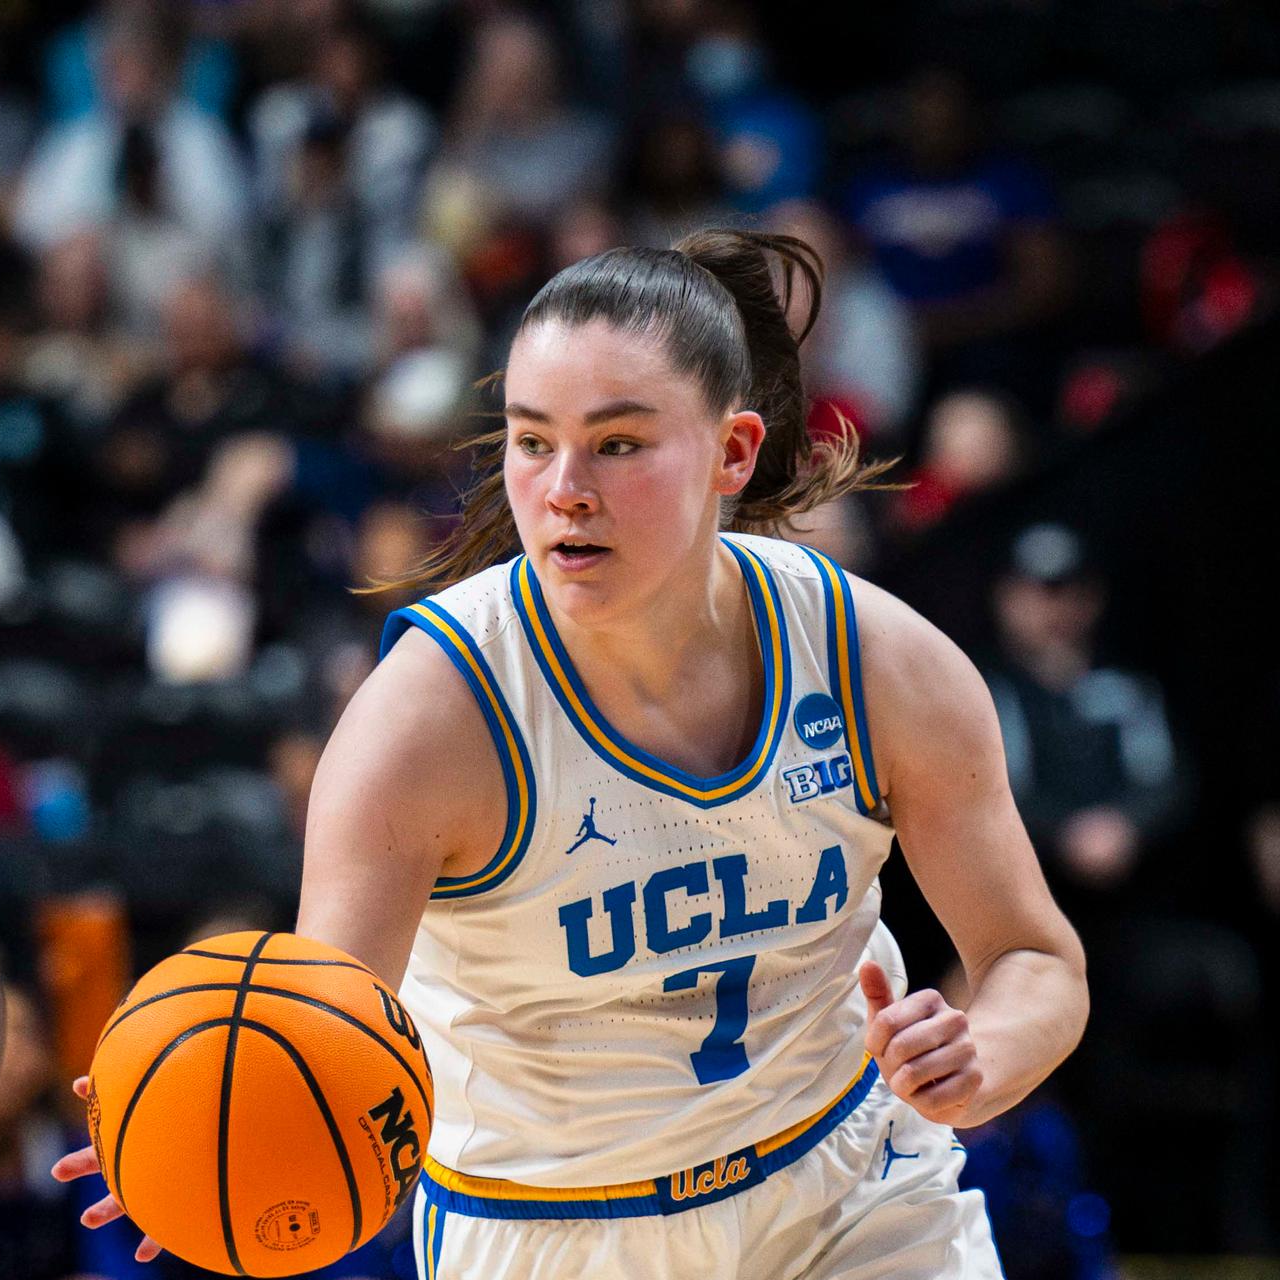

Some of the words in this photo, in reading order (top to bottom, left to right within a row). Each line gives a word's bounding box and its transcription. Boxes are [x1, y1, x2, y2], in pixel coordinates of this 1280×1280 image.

[803, 715, 843, 738] NCAA
[558, 845, 849, 978] UCLA
[662, 954, 757, 1086] 7
[358, 1116, 385, 1175] OFFICIAL
[671, 1155, 751, 1201] Ucla
